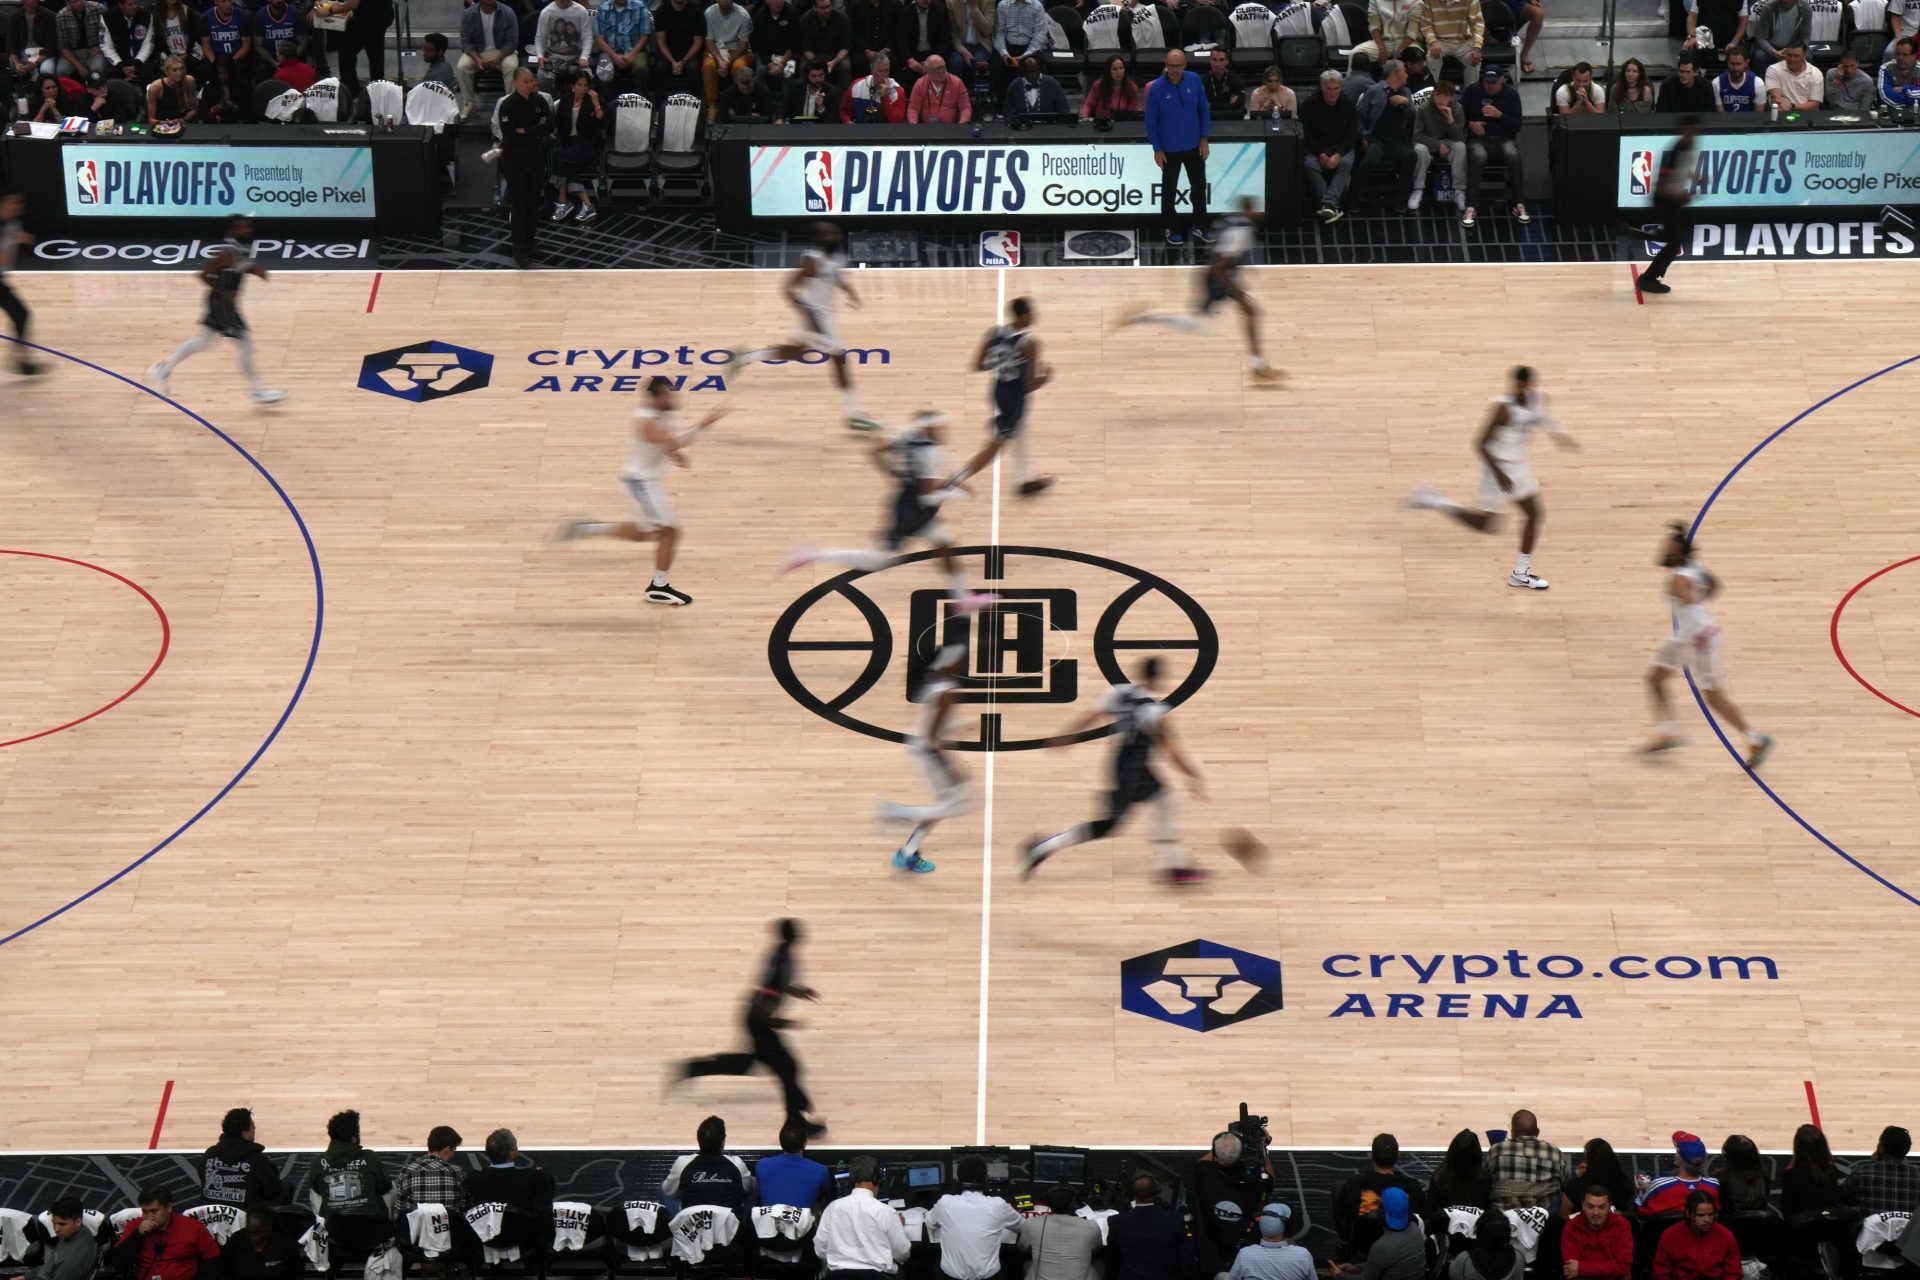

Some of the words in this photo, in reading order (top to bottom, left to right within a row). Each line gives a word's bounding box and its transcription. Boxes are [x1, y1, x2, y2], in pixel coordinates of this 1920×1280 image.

[1236, 6, 1269, 14] CLIPPER
[211, 30, 240, 41] CLIPPERS
[265, 27, 294, 39] CLIPPERS
[172, 38, 184, 50] 14
[1723, 95, 1750, 104] CLIPPERS
[1042, 152, 1107, 177] Presented
[1109, 152, 1125, 180] by
[1804, 151, 1854, 169] Presented
[1854, 152, 1867, 171] by
[244, 163, 288, 182] Presented
[289, 164, 303, 184] by
[841, 149, 1029, 213] PLAYOFFS
[1662, 149, 1797, 195] AYOFFS
[104, 161, 236, 206] PLAYOFFS
[1804, 173, 1878, 194] Google
[246, 186, 318, 207] Google
[322, 187, 367, 204] Pixel
[807, 199, 824, 210] NBA
[1042, 183, 1144, 212] Google
[1150, 182, 1212, 206] Pxl
[33, 239, 229, 265] Google
[249, 238, 370, 260] Pixel
[985, 257, 1005, 265] NBA
[1322, 949, 1779, 984] crypto.com
[1328, 993, 1584, 1019] ARENA
[691, 1171, 733, 1184] Balmain
[467, 1204, 504, 1224] CLIPPE
